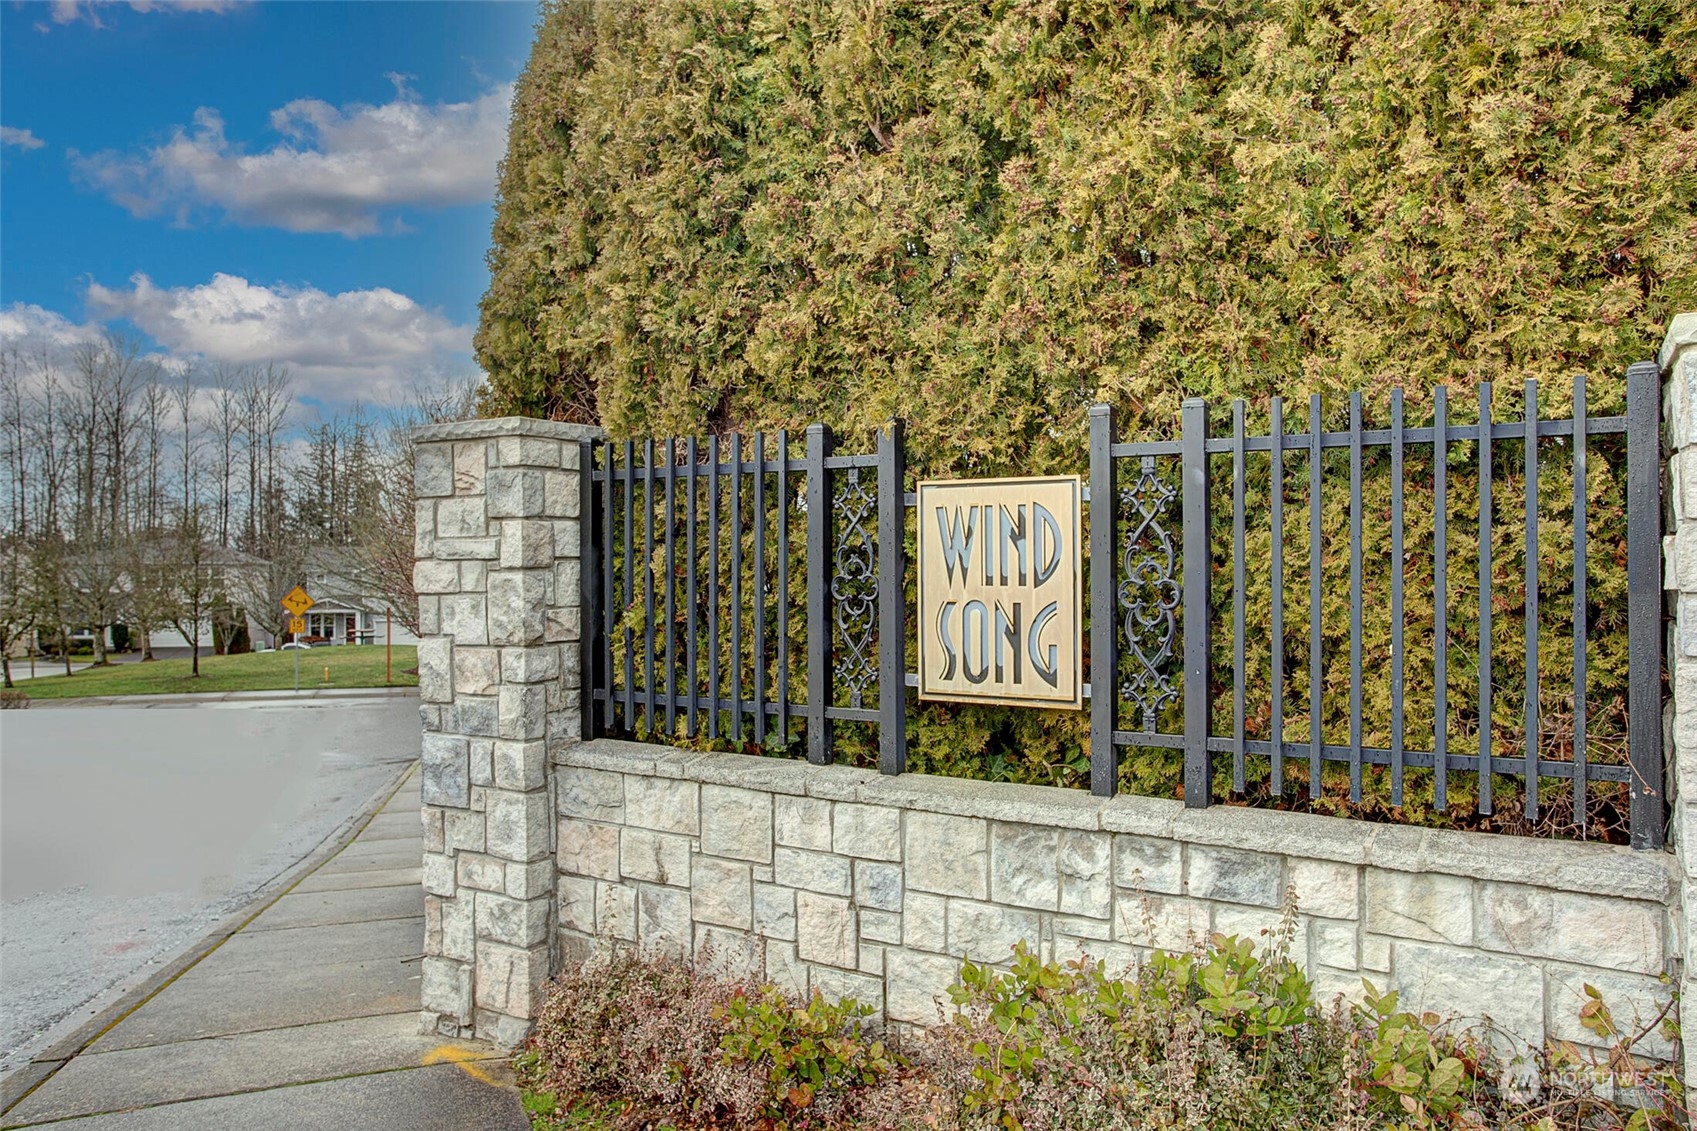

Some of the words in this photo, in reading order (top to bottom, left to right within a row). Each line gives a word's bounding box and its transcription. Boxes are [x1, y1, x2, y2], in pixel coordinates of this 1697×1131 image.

[935, 501, 1063, 590] WIND
[292, 620, 303, 628] 15
[935, 598, 1058, 690] SONG
